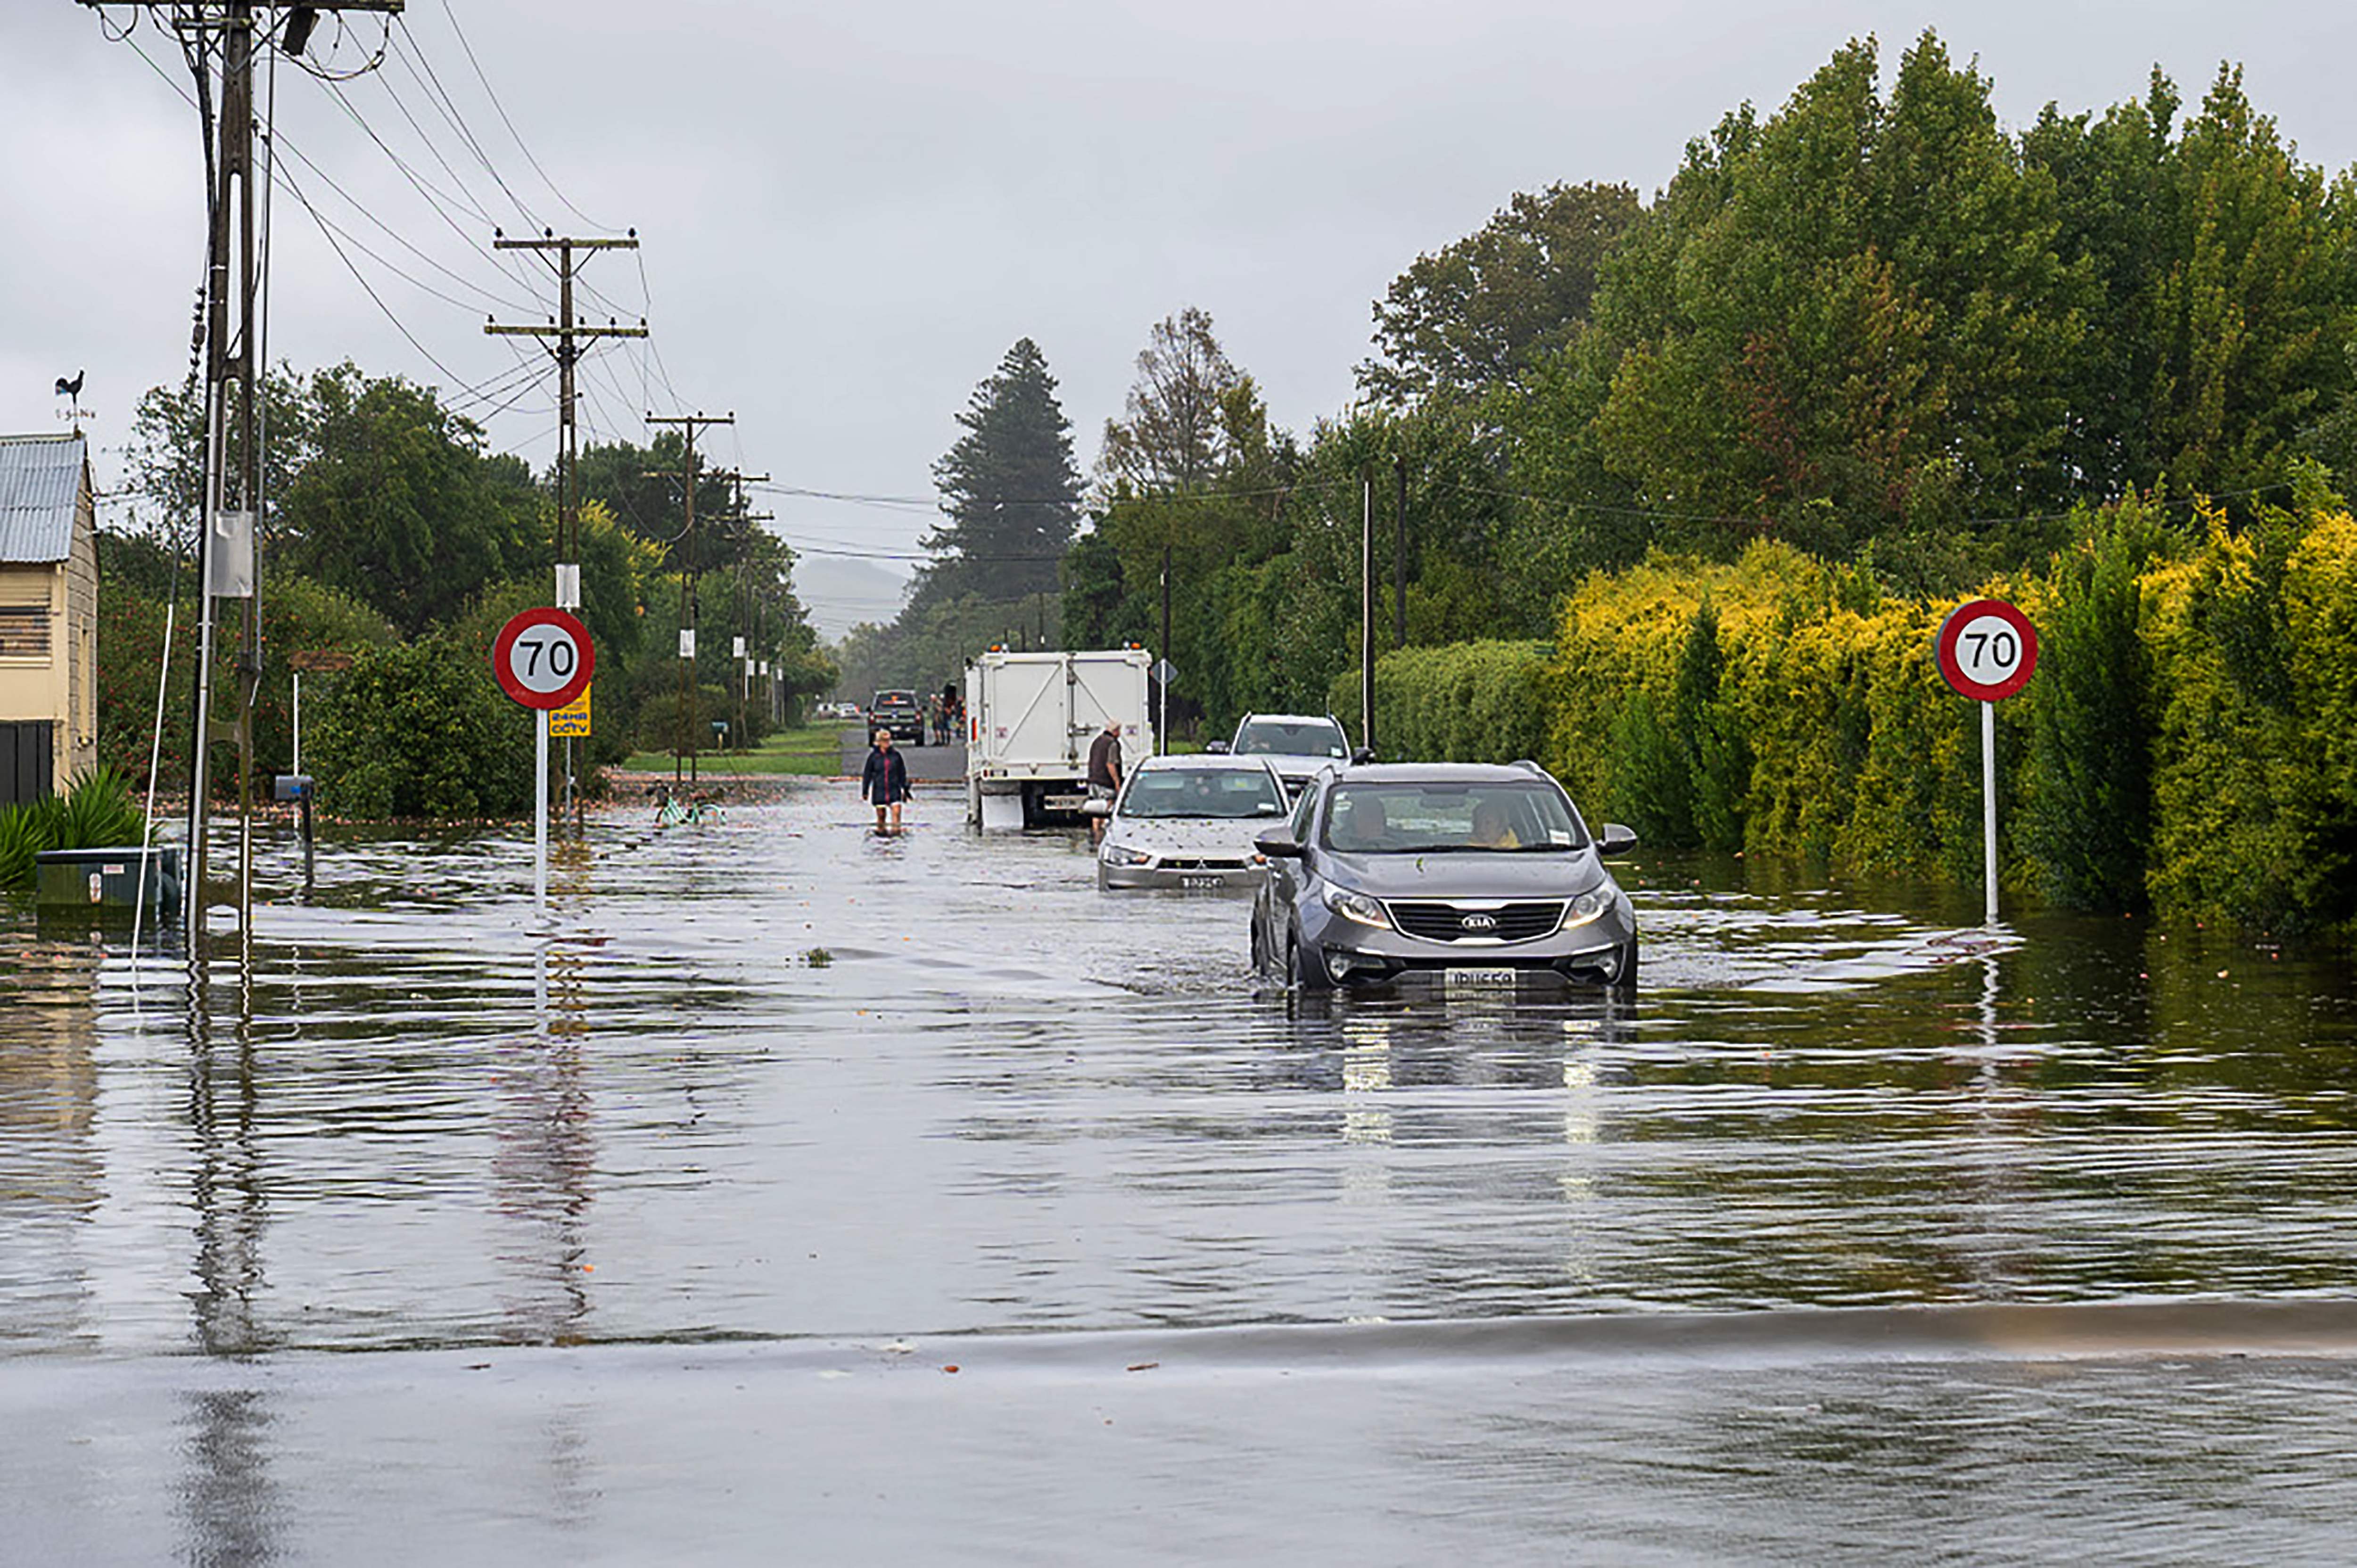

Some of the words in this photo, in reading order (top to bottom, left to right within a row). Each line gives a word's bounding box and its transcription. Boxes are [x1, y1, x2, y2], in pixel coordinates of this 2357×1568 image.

[519, 640, 573, 676] 70
[1965, 632, 2015, 667] 70
[552, 723, 587, 733] CCTV
[1469, 919, 1491, 928] KIA
